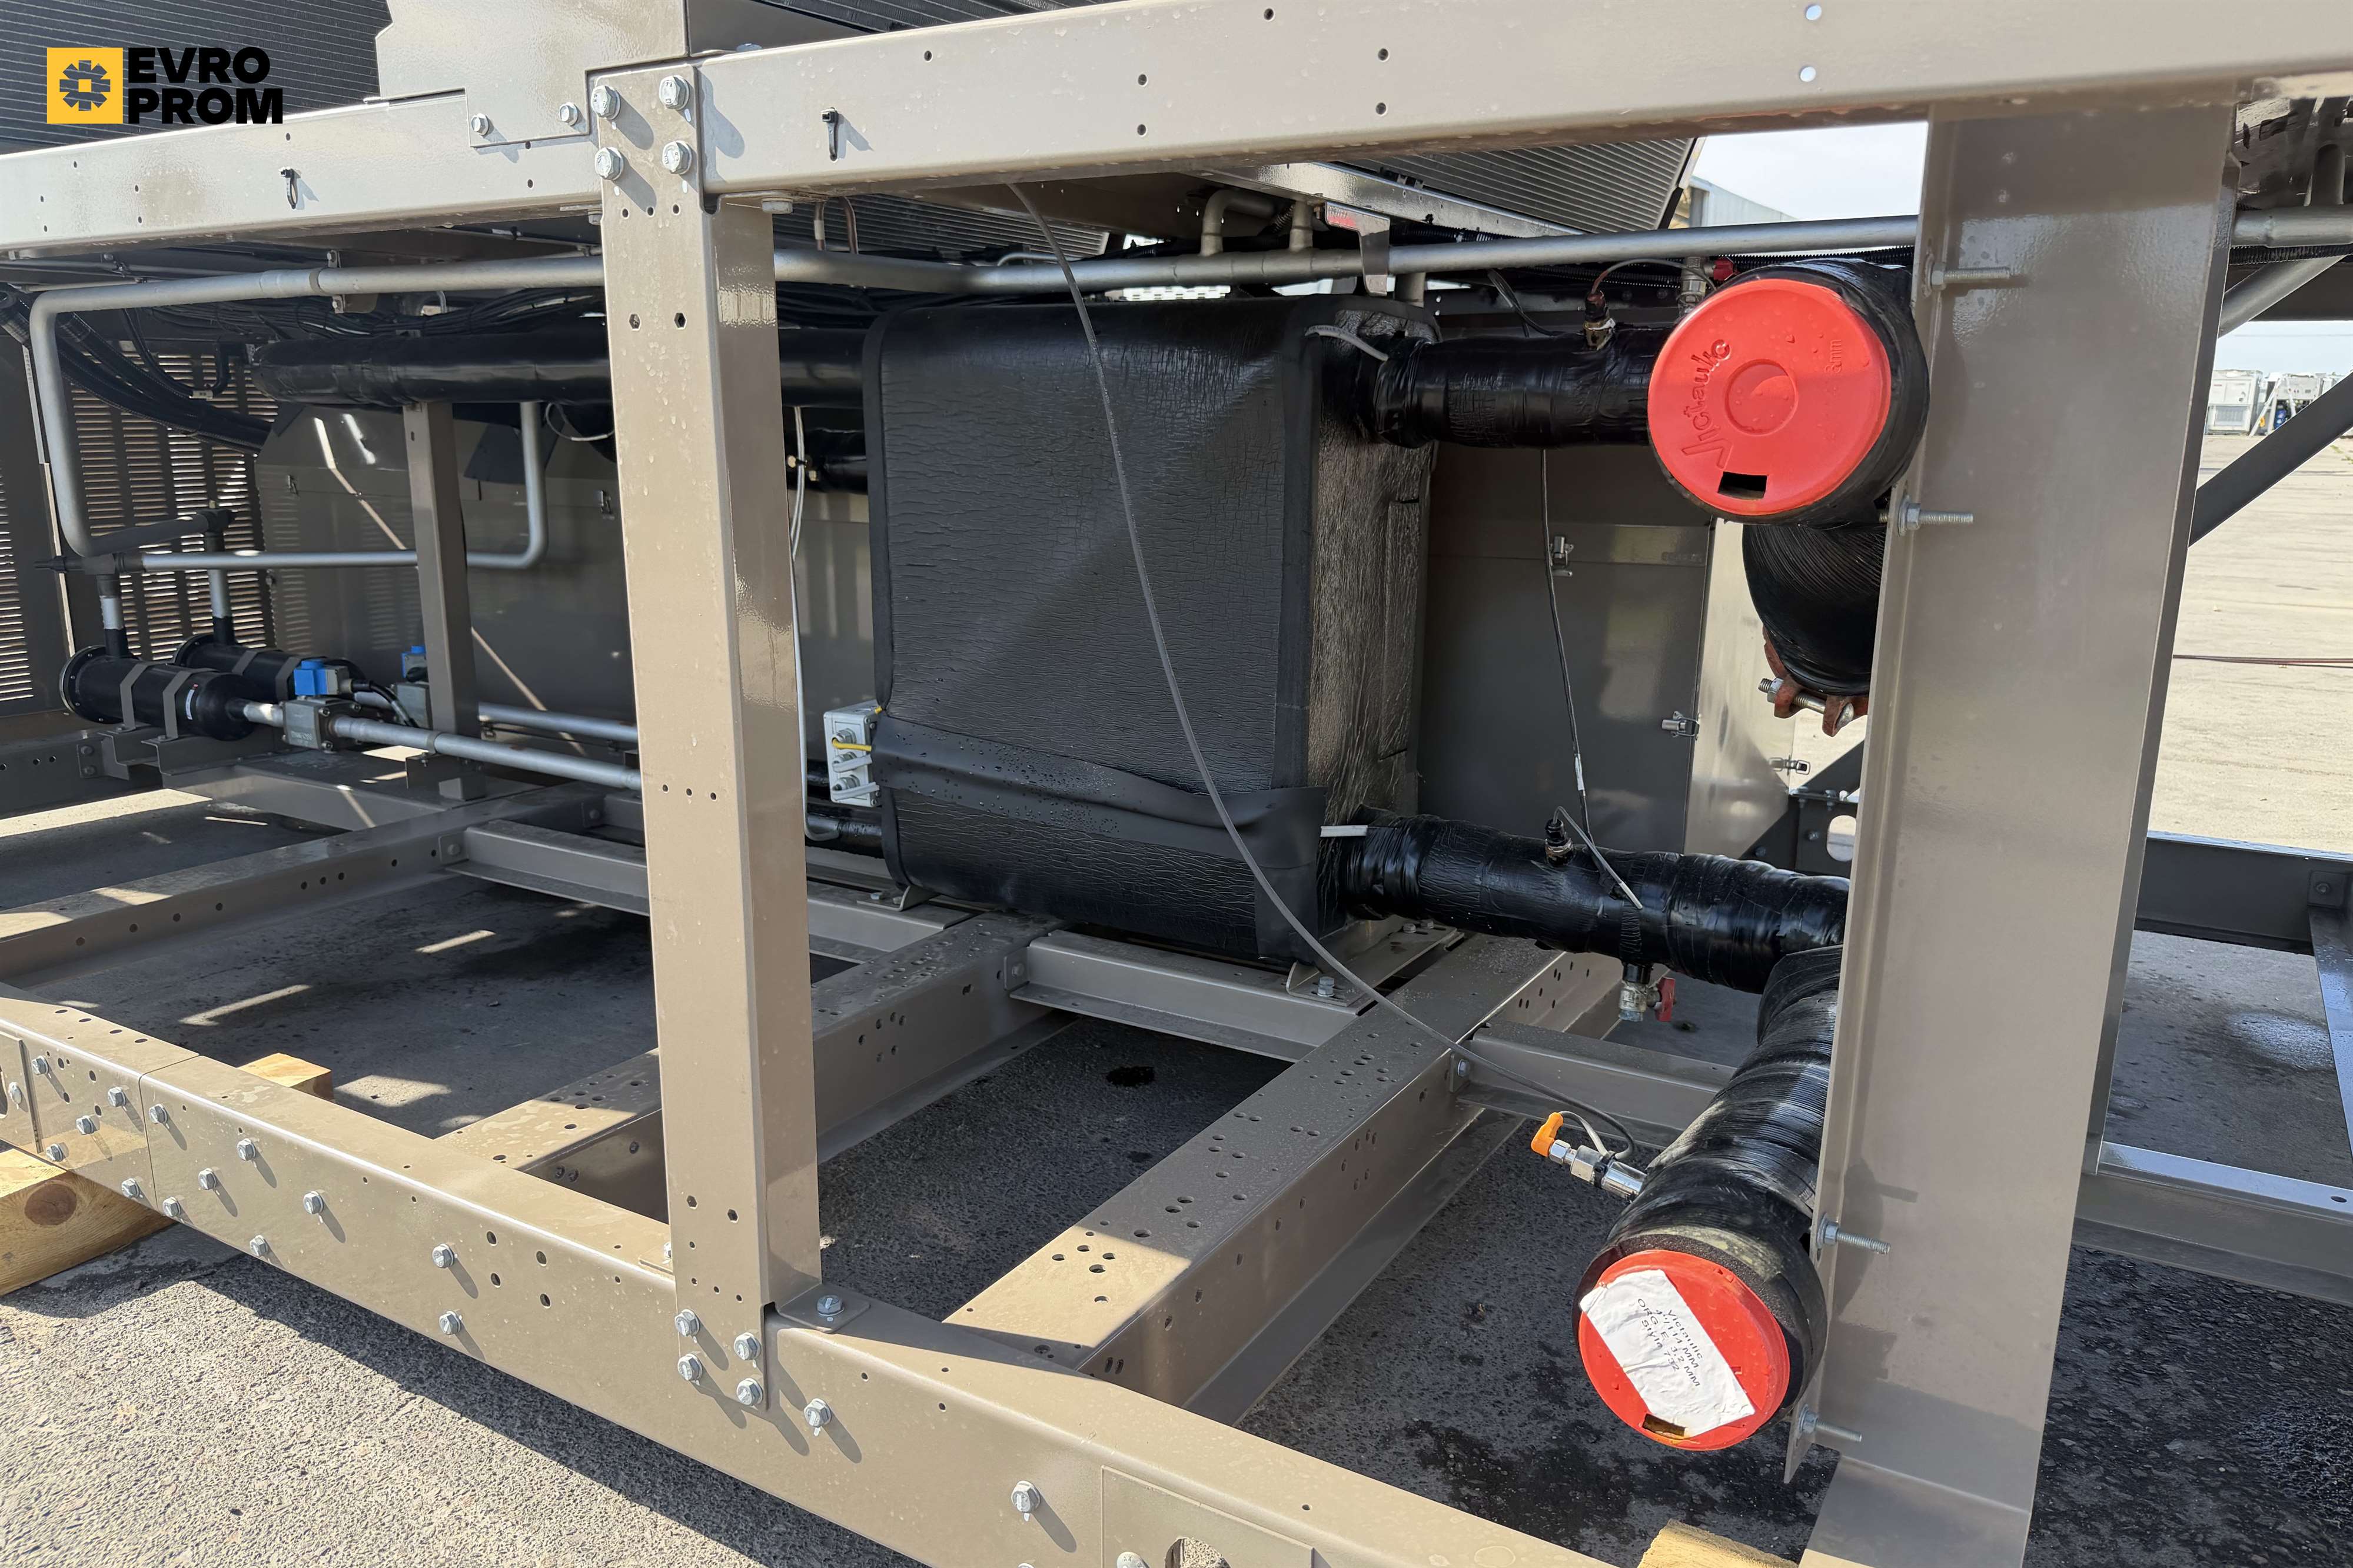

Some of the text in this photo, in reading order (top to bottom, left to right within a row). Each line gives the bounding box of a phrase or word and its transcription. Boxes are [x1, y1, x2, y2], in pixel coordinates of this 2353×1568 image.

[1637, 1299, 1659, 1325] ORG
[1684, 1366, 1700, 1387] MM
[1668, 1309, 1703, 1359] Victaulic
[1683, 1347, 1700, 1369] MM
